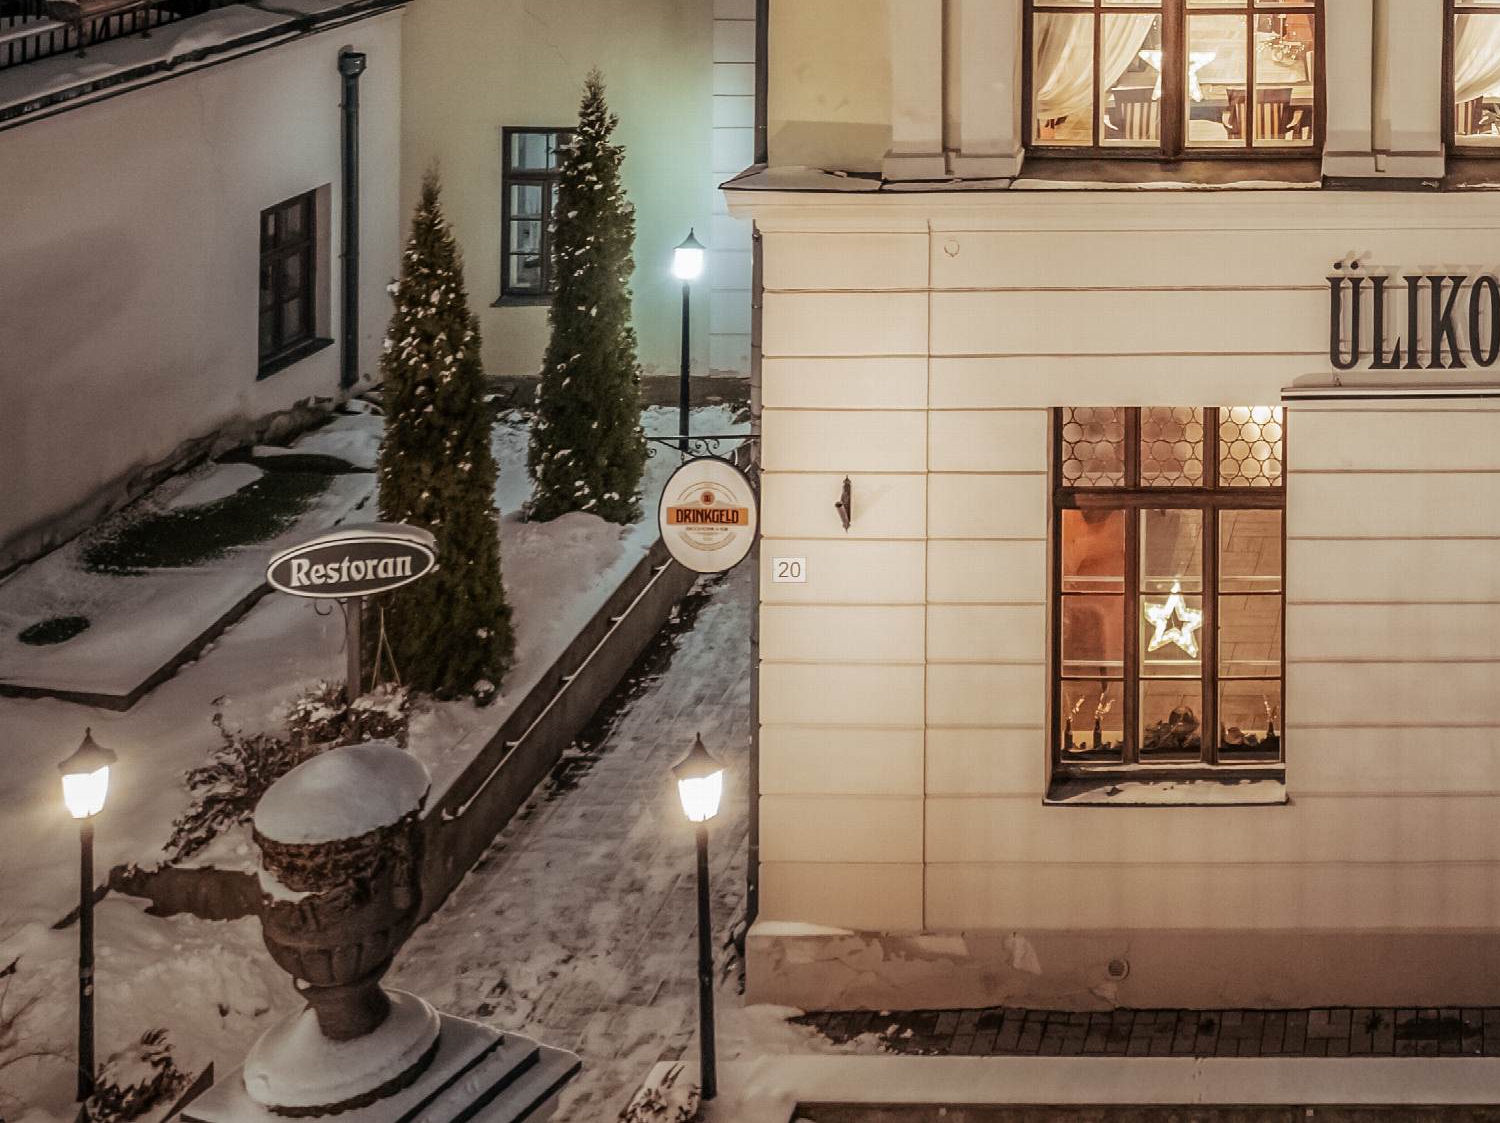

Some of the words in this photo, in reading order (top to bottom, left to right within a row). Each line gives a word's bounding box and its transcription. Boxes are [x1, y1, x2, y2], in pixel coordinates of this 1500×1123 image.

[676, 509, 739, 524] DRINKGELD
[290, 556, 412, 588] Restoran
[778, 562, 801, 578] 20
